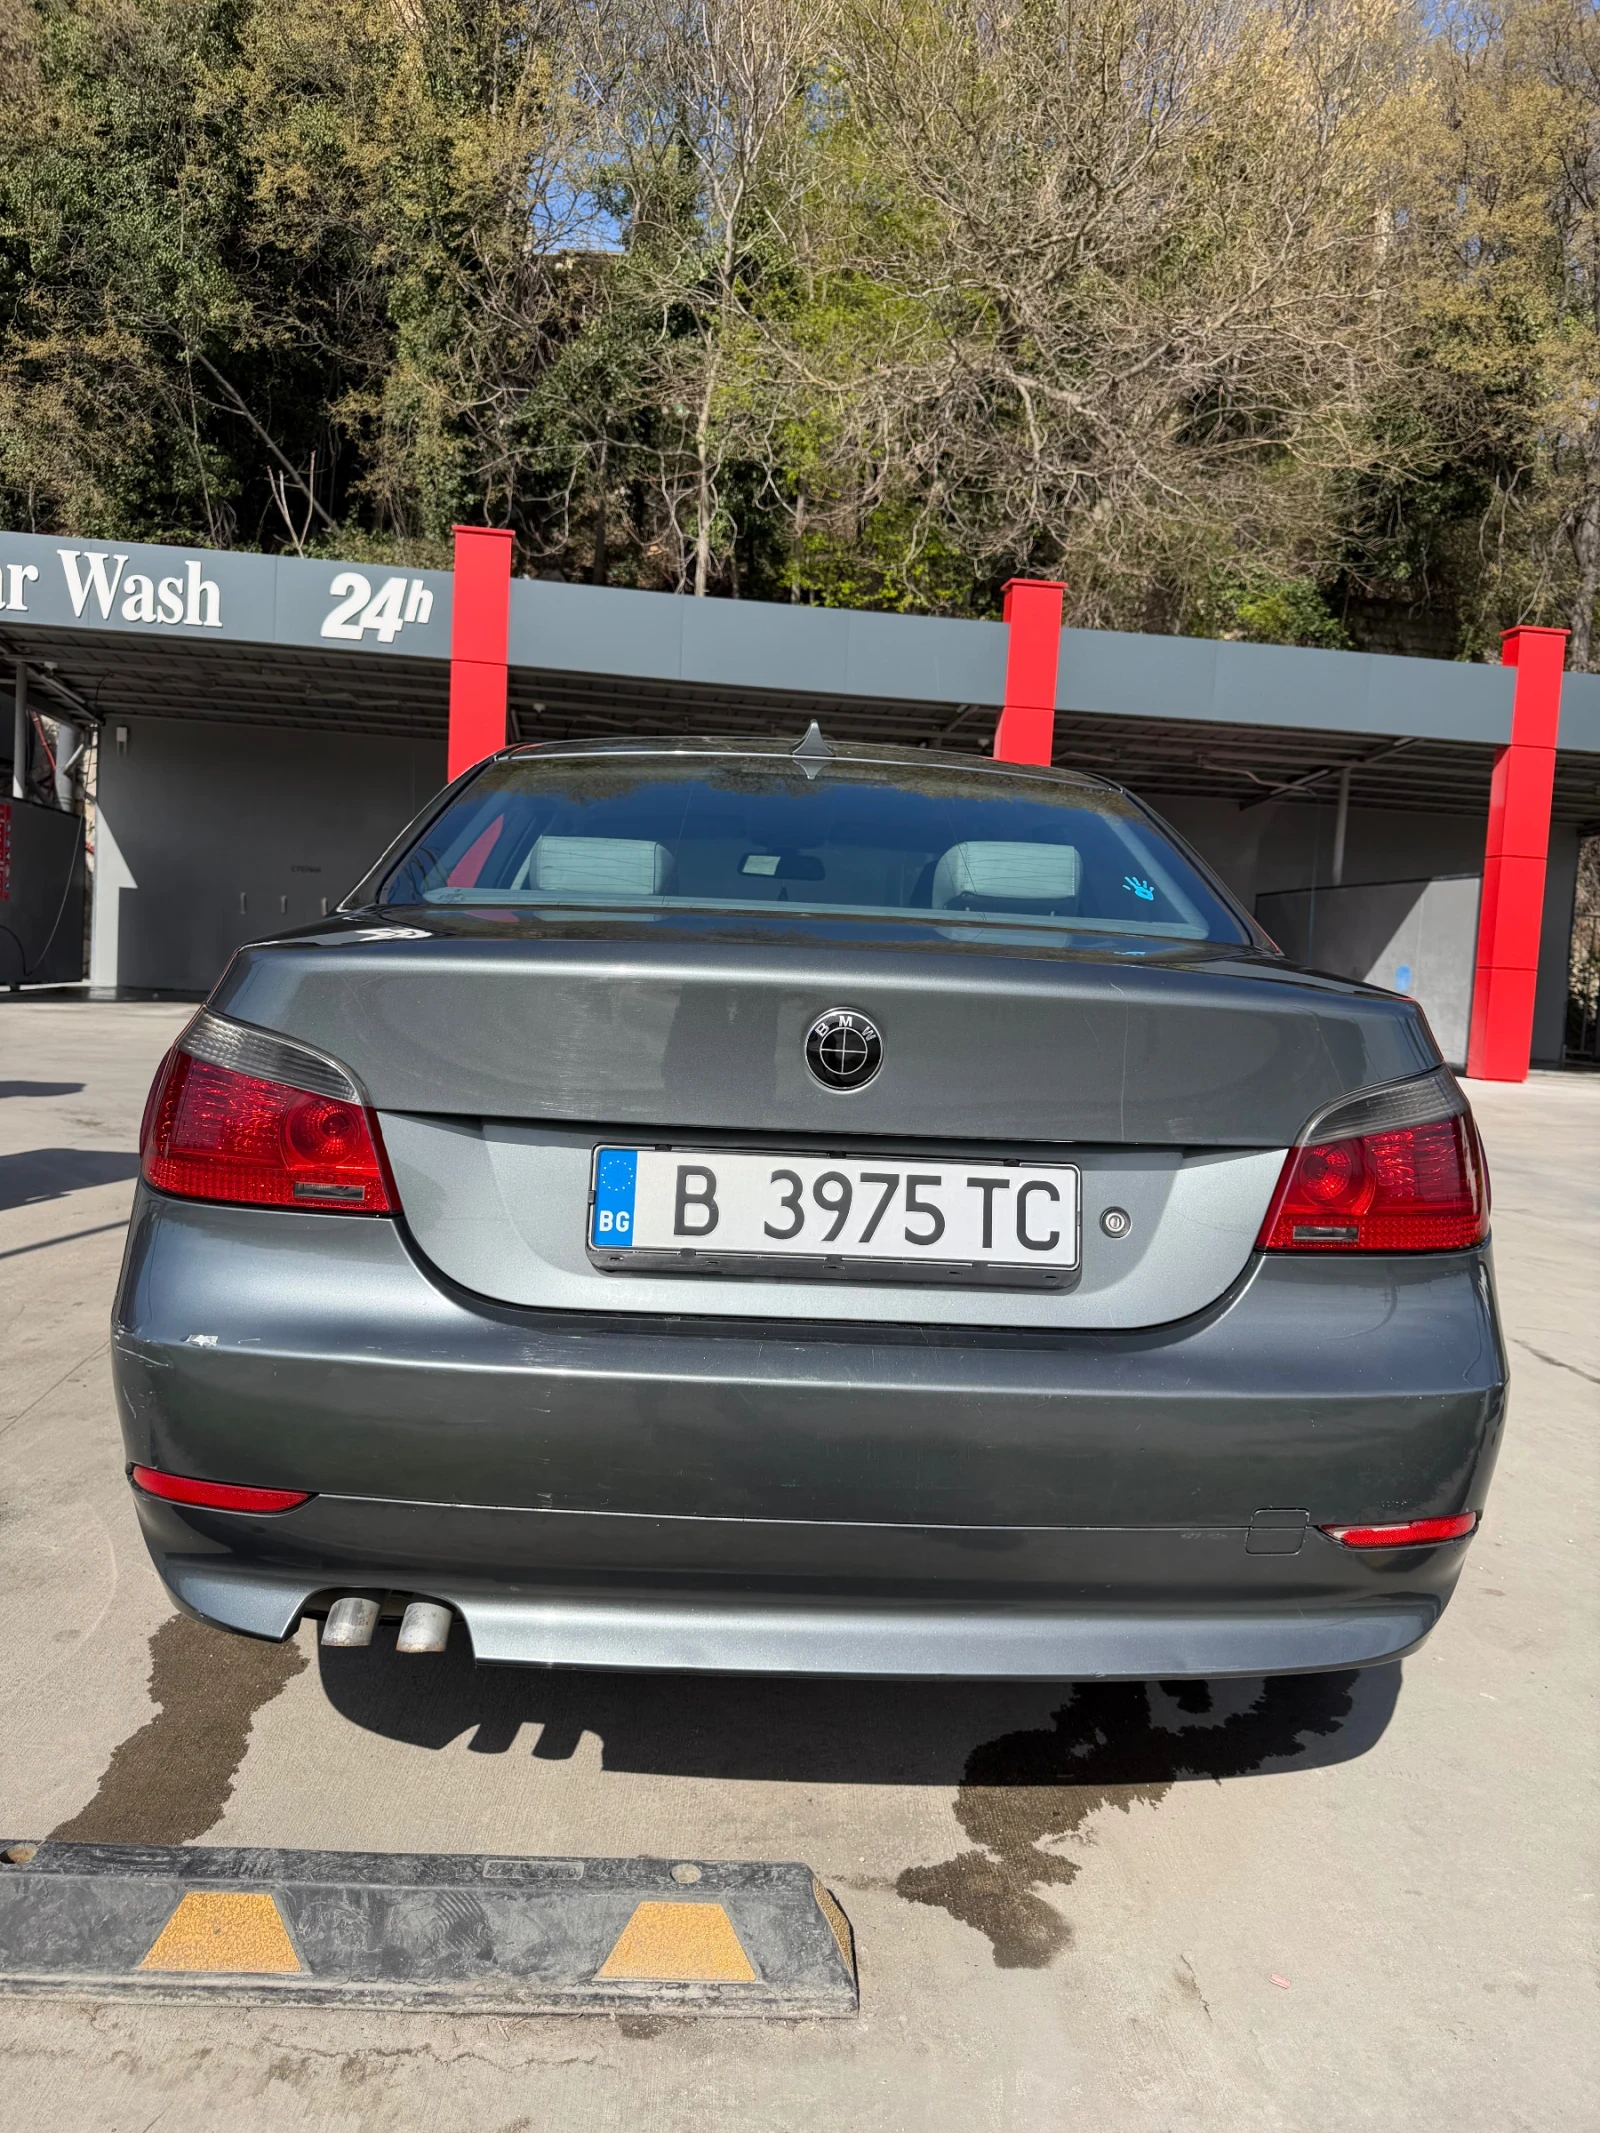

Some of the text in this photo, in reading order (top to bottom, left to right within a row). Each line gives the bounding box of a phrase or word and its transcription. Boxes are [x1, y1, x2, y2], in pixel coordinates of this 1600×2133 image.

[0, 549, 222, 627] r Wash
[321, 572, 434, 643] 24h
[815, 1015, 877, 1041] BMW
[599, 1210, 630, 1232] BG
[674, 1165, 1060, 1251] B 3975 TC
